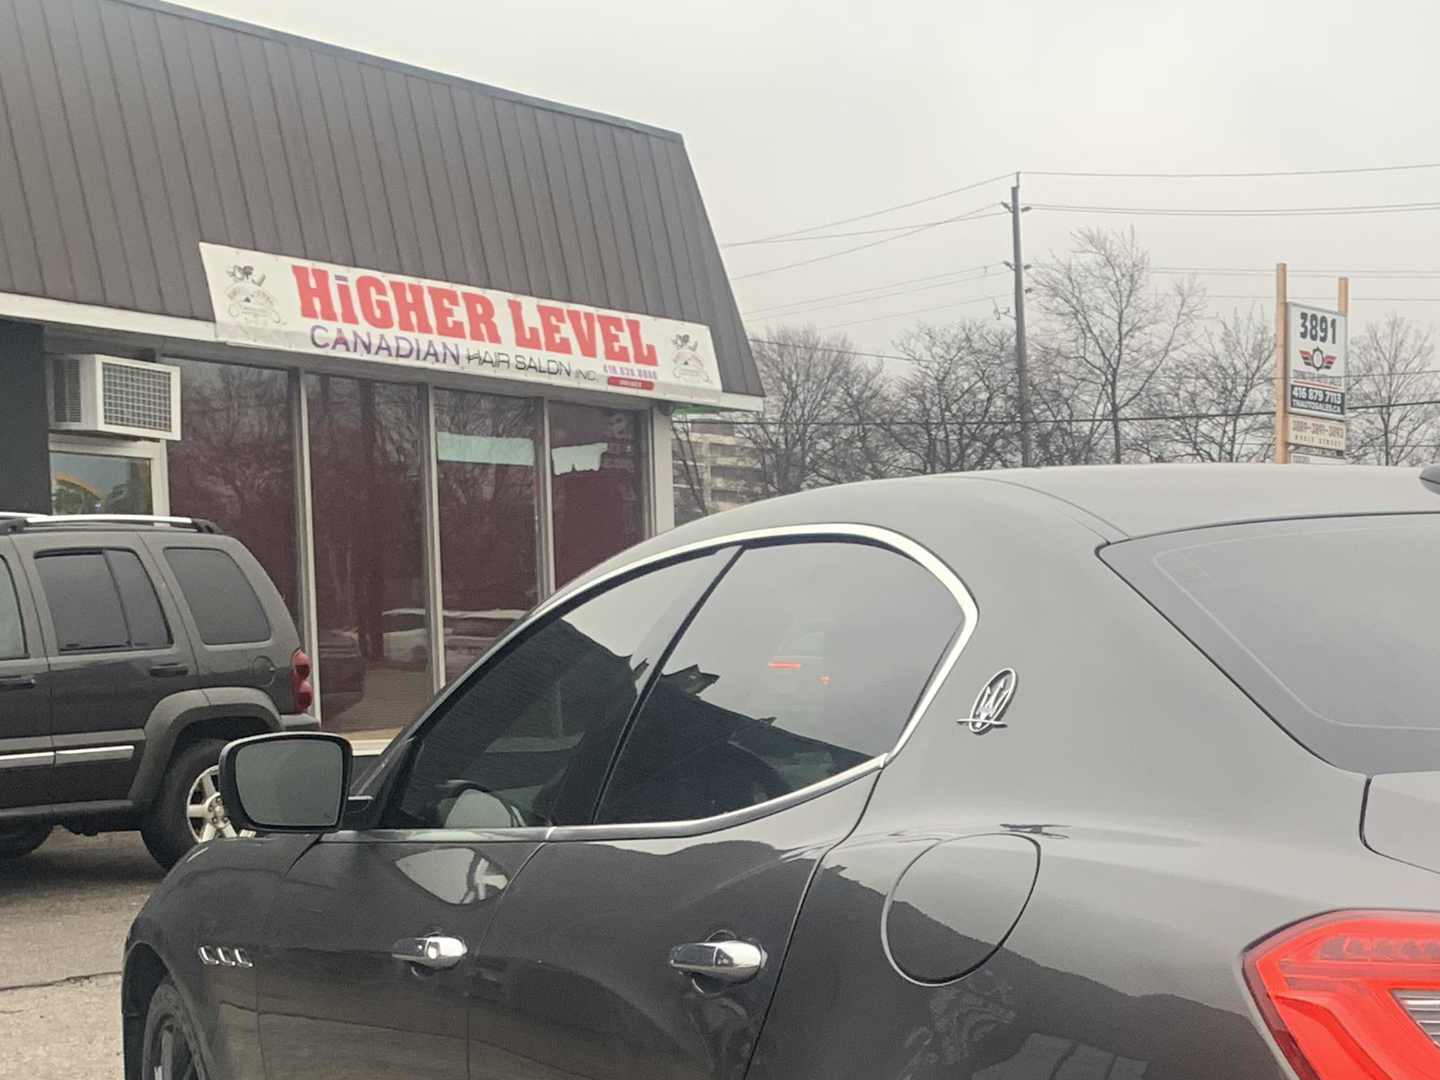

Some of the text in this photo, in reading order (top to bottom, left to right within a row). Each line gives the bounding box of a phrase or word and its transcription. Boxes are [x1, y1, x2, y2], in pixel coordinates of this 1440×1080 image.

[310, 324, 461, 366] CANADIAN
[465, 348, 511, 369] HAIR
[514, 354, 572, 377] SALON
[508, 298, 658, 366] LEVEL
[1300, 311, 1337, 345] 3891
